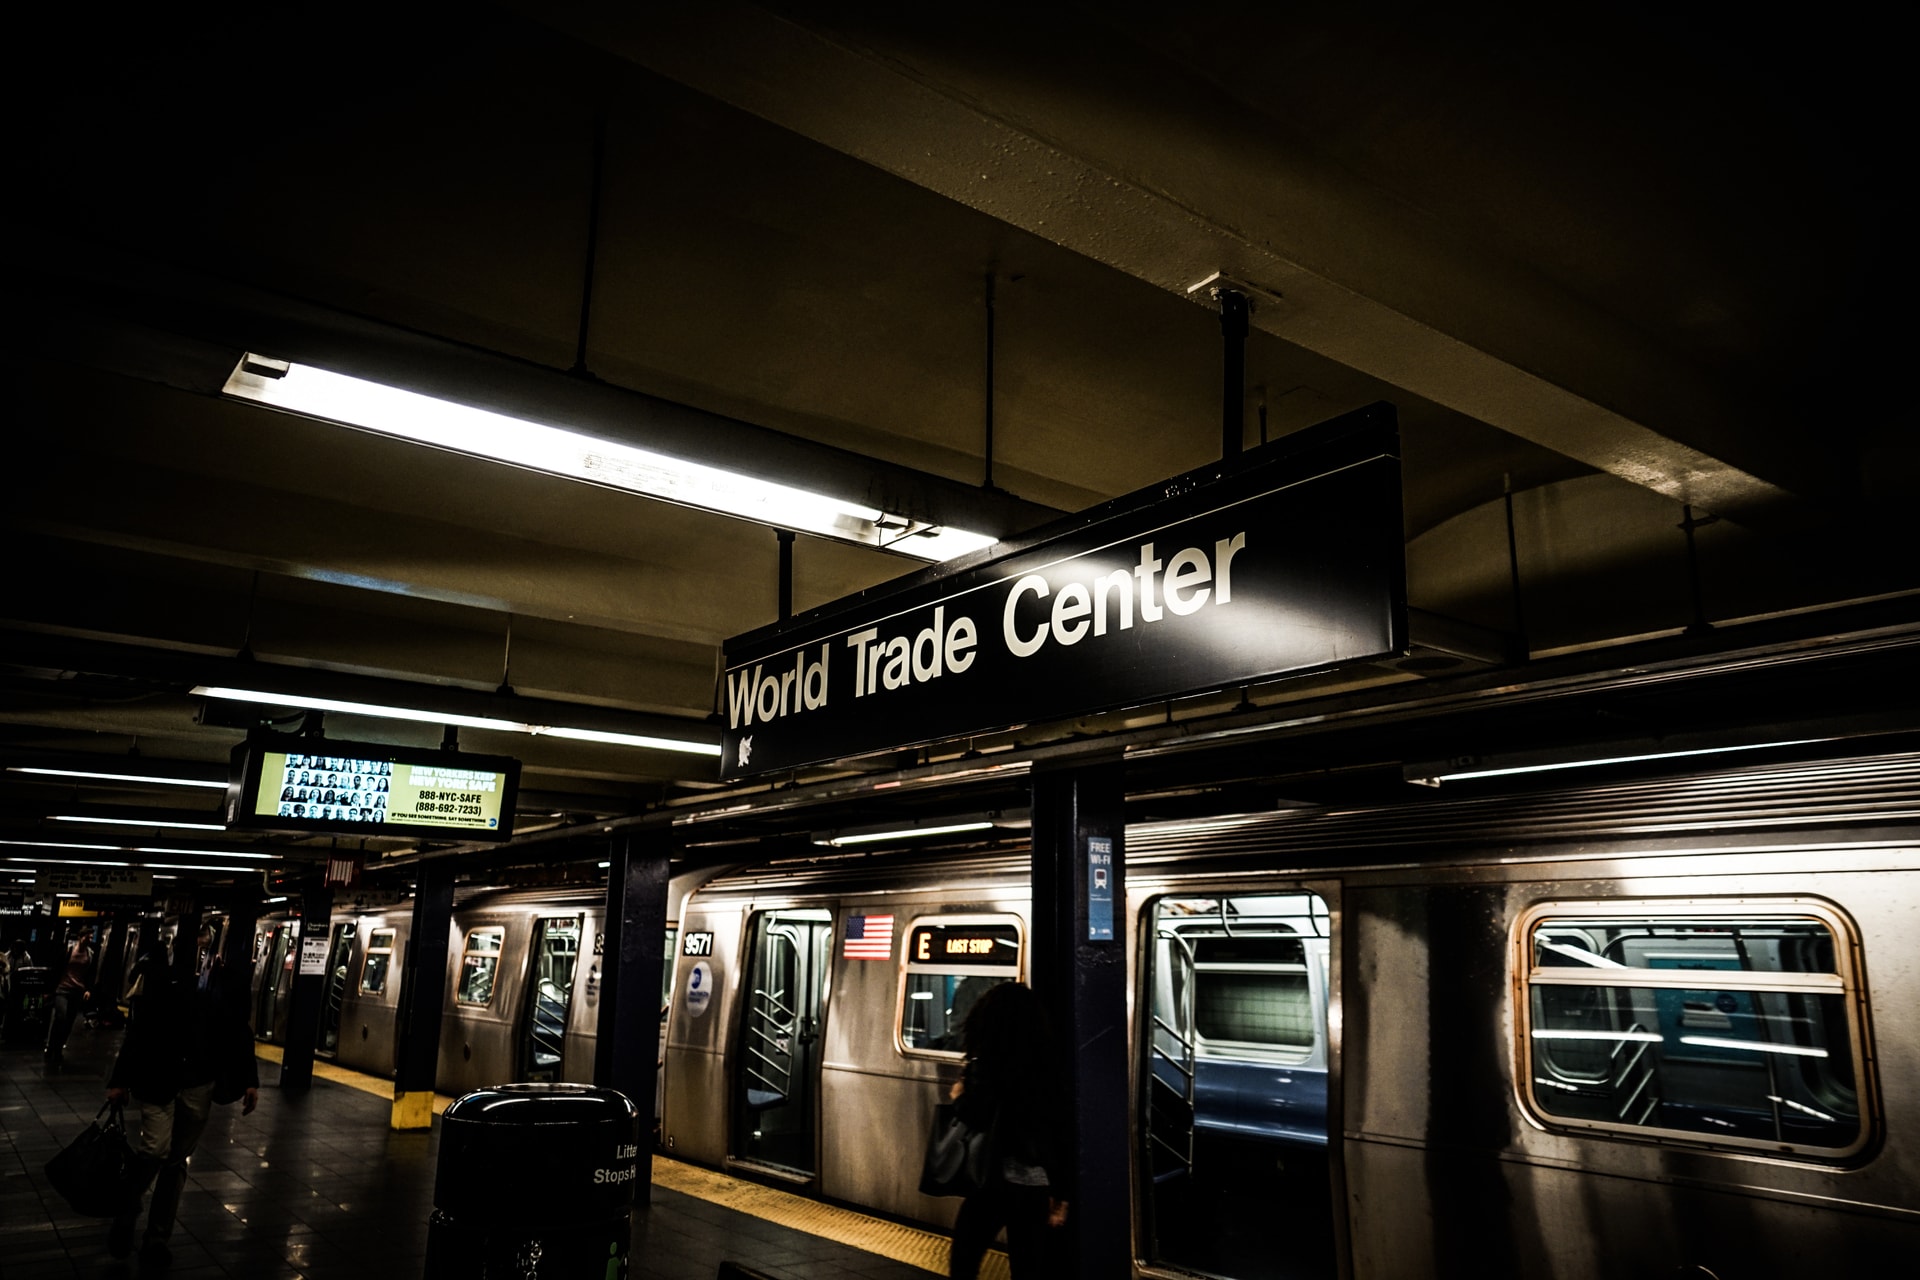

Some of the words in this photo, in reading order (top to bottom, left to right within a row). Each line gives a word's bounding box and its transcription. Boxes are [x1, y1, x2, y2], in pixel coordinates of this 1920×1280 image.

[727, 643, 829, 729] World
[848, 606, 978, 698] Trade
[1003, 531, 1245, 657] Center
[411, 766, 433, 777] NEW
[434, 768, 474, 780] YORKERS
[474, 771, 496, 782] KEEP
[409, 775, 437, 788] NEW
[438, 778, 468, 791] YORK
[468, 780, 496, 793] SAFE
[419, 790, 482, 804] 888-NYC-SAFE
[416, 802, 482, 817] (888-692-7233)
[1090, 841, 1111, 853] FREE
[1090, 854, 1111, 865] WI-FI
[685, 932, 712, 955] 9571
[918, 932, 931, 960] E
[946, 938, 969, 954] LAST
[969, 938, 993, 954] STOP
[593, 1167, 630, 1186] Stops
